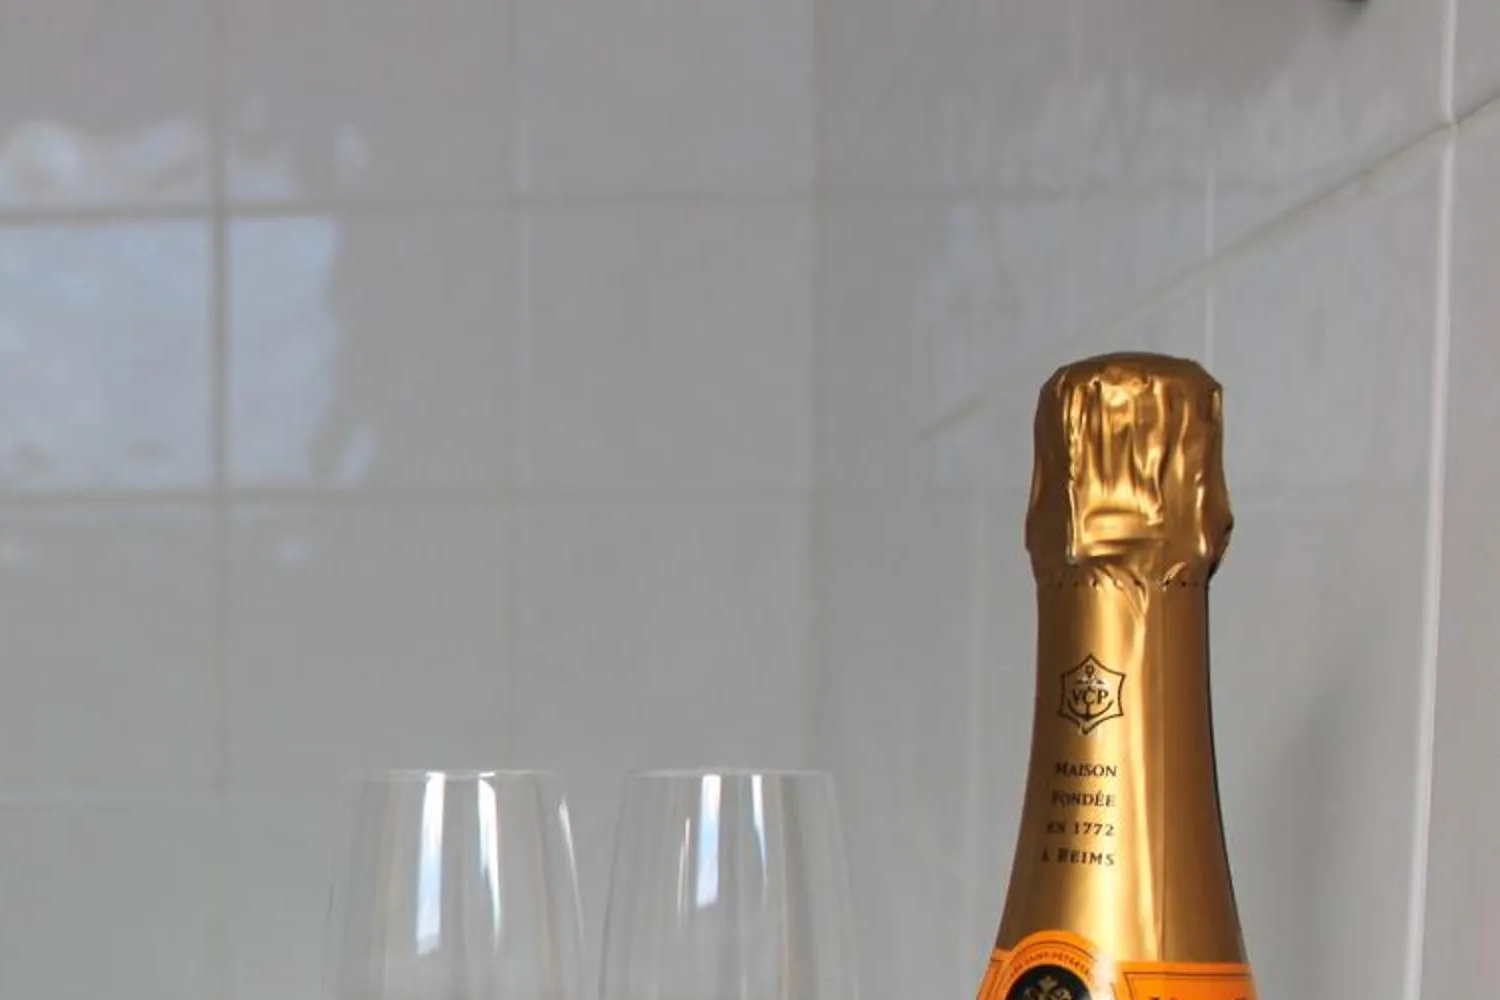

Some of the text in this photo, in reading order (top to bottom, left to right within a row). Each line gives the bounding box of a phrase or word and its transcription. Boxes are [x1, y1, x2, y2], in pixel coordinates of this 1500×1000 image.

[1071, 688, 1109, 705] VCP
[1055, 762, 1118, 777] MAISON
[1051, 790, 1116, 807] FONDÉE
[1046, 821, 1115, 836] EN 1772
[1058, 847, 1115, 866] REIMS
